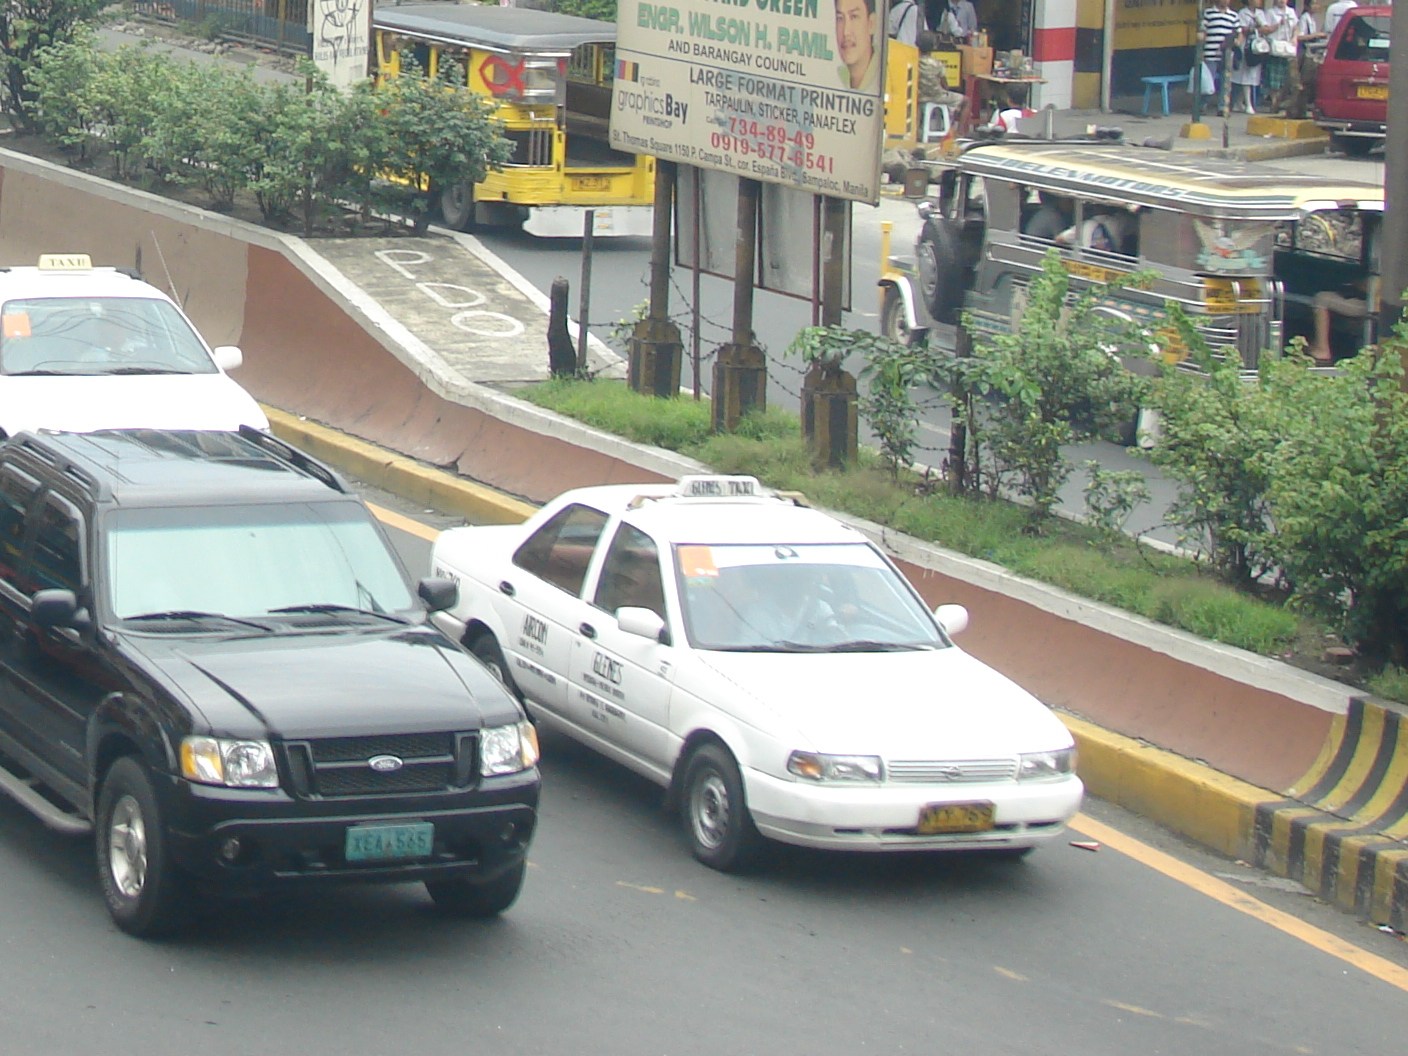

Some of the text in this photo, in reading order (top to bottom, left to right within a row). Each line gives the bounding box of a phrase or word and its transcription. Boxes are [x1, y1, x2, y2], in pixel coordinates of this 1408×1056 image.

[636, 2, 834, 61] ENGR. WILSON H. RAMIL
[667, 39, 806, 77] AND BARANGAY COUNCIL
[617, 90, 689, 125] graphicsBay
[689, 66, 734, 91] LARGE
[737, 76, 796, 105] FORMAT
[800, 87, 874, 118] PRINTING
[704, 90, 756, 116] TARPAULIN,
[758, 102, 801, 126] STICKER,
[802, 110, 857, 136] PANAFLEX
[710, 131, 833, 175] 0919-577-6541
[728, 116, 815, 151] 734-89-49
[623, 132, 649, 149] Thomas
[649, 137, 674, 155] Square
[674, 143, 690, 158] 1150
[690, 147, 698, 160] P.
[698, 149, 723, 167] Campa
[737, 160, 750, 172] cor.
[751, 161, 780, 179] España
[801, 171, 841, 195] Sampaloc,
[843, 180, 869, 198] Manila
[728, 481, 754, 496] TAXI
